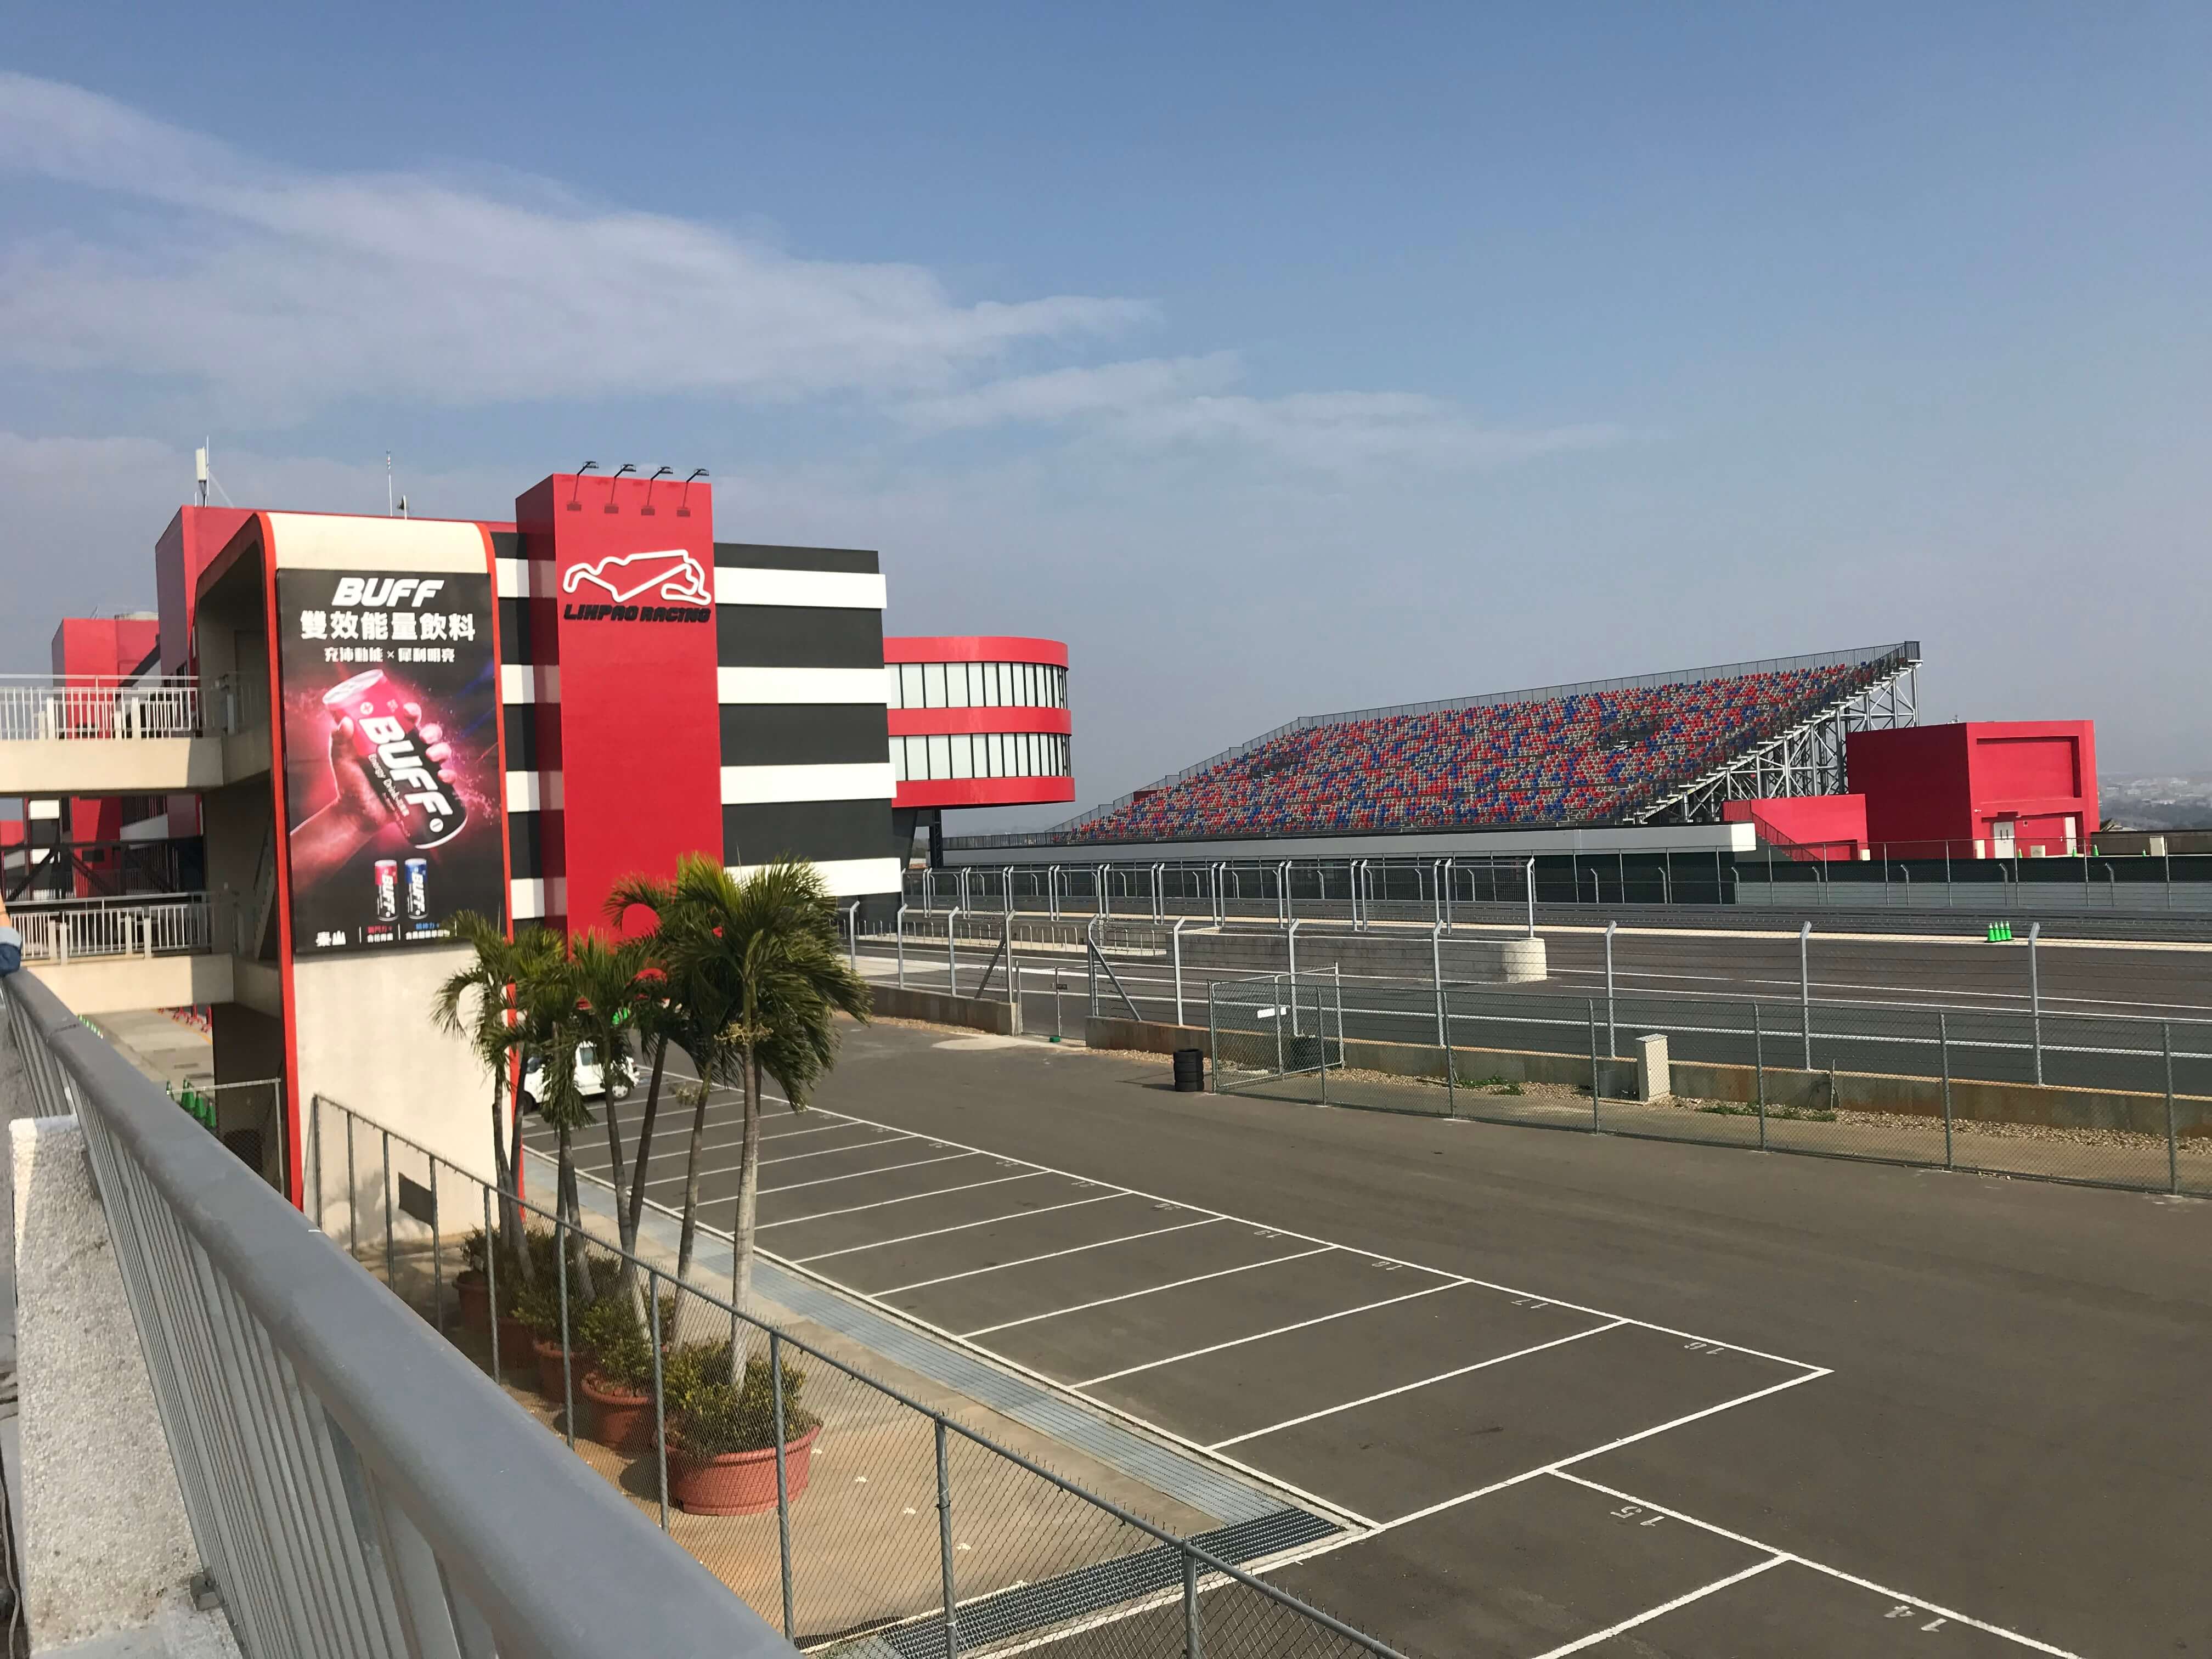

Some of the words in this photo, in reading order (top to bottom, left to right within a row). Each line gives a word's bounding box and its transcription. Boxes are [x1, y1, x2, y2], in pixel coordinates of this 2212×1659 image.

[331, 577, 444, 607] BUFF
[300, 610, 476, 641] 雙效能量飲料
[563, 604, 638, 621] LIHPAO
[639, 607, 712, 623] RACING
[358, 715, 454, 816] BUFF
[368, 753, 386, 778] Energy
[382, 873, 396, 915] BUFF
[411, 871, 426, 912] BUFF
[1371, 1261, 1403, 1271] 18
[1510, 1299, 1549, 1309] 17
[1684, 1342, 1725, 1355] 16
[1610, 1506, 1664, 1527] 15
[1884, 1605, 1948, 1632] 14
